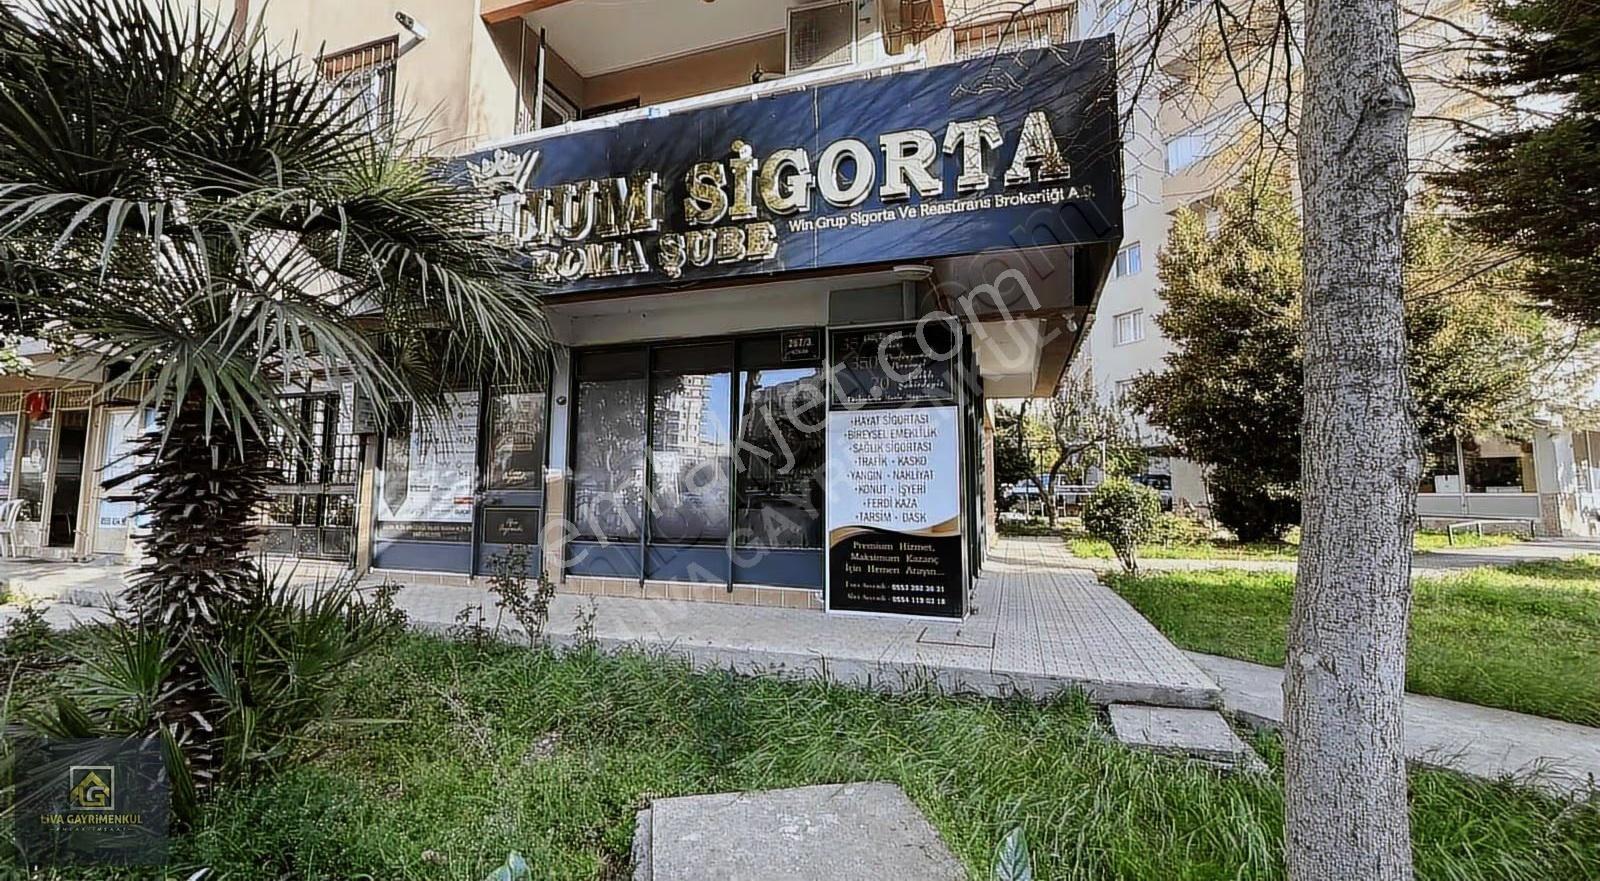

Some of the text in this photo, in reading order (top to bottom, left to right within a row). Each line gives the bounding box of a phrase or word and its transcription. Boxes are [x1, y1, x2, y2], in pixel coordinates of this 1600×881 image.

[684, 110, 1071, 225] SİGORTA
[788, 219, 813, 232] Win
[815, 215, 847, 229] Grup
[850, 208, 896, 226] Sigorta
[899, 204, 917, 219] Ve
[920, 196, 991, 217] Reasürans
[657, 221, 779, 279] ŞUBE
[854, 413, 929, 425] HAYAT SİGORTASI
[848, 426, 937, 440] BİREYSEL EMEKLİLİK
[853, 440, 931, 453] SAĞLIK SİGORTASI
[858, 454, 927, 466] TRAFİK KASKO
[850, 467, 934, 480] YANGIN NAKLİYAT
[858, 481, 926, 496] KONUT İŞYERİ
[867, 496, 918, 508] FERDİ KAZA
[860, 509, 927, 522] TARSİM DASK
[853, 541, 936, 552] Premium Hizmet,
[850, 552, 940, 565] Maksimum Kazanç
[845, 561, 861, 574] İçin
[867, 564, 899, 574] Hemen
